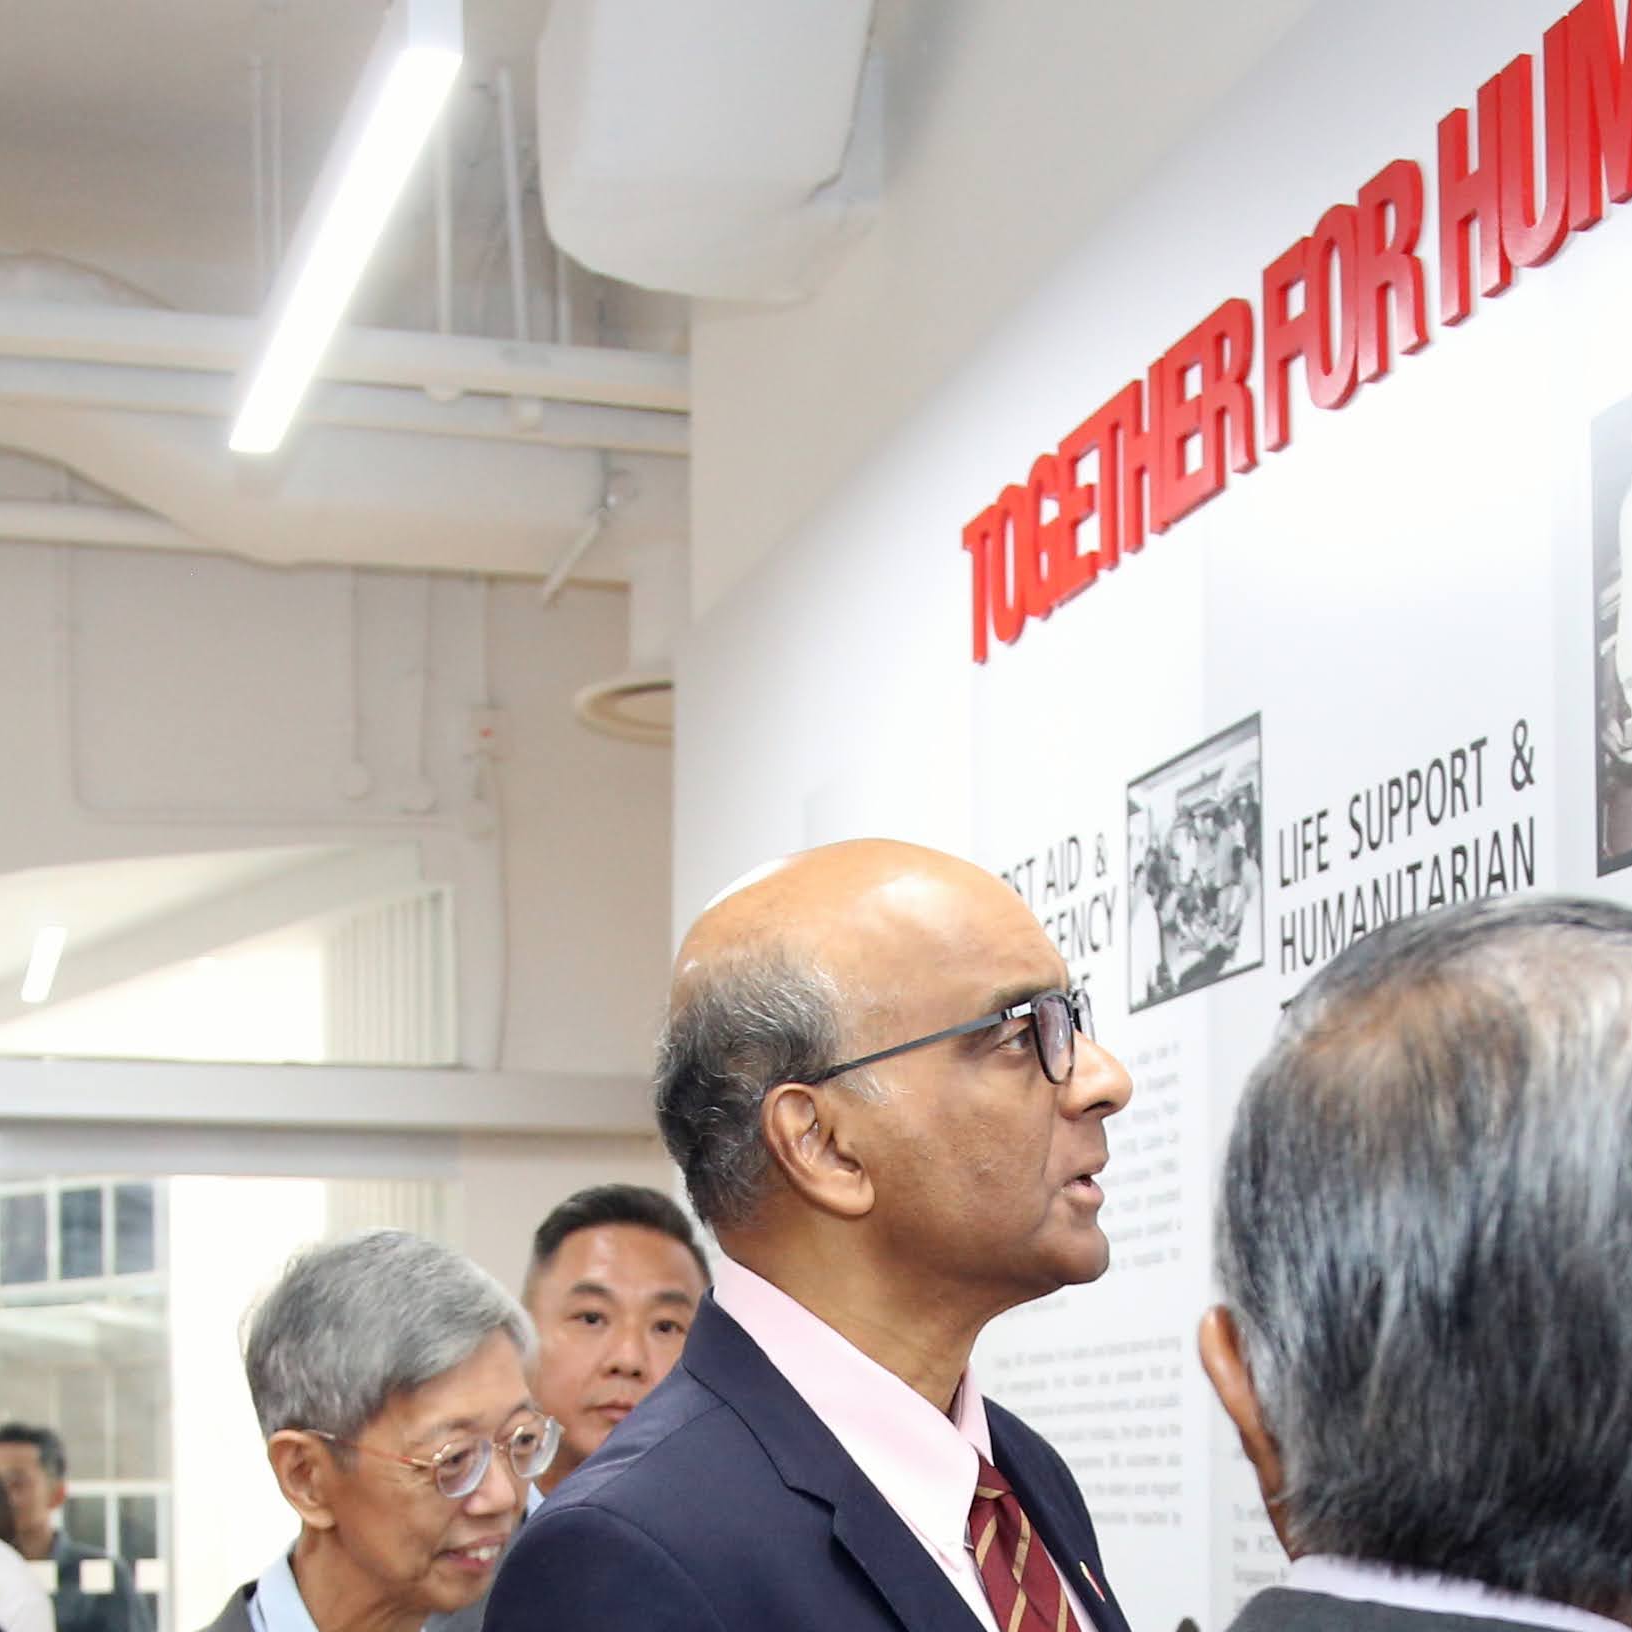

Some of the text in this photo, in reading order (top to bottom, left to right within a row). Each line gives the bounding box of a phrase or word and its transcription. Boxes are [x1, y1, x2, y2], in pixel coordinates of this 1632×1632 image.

[962, 298, 1258, 664] TOGETHER
[1262, 159, 1430, 454] FOR
[1043, 835, 1083, 905] AID
[1279, 718, 1535, 888] LIFE SUPPORT &
[1280, 815, 1535, 975] HUMANITARIAN
